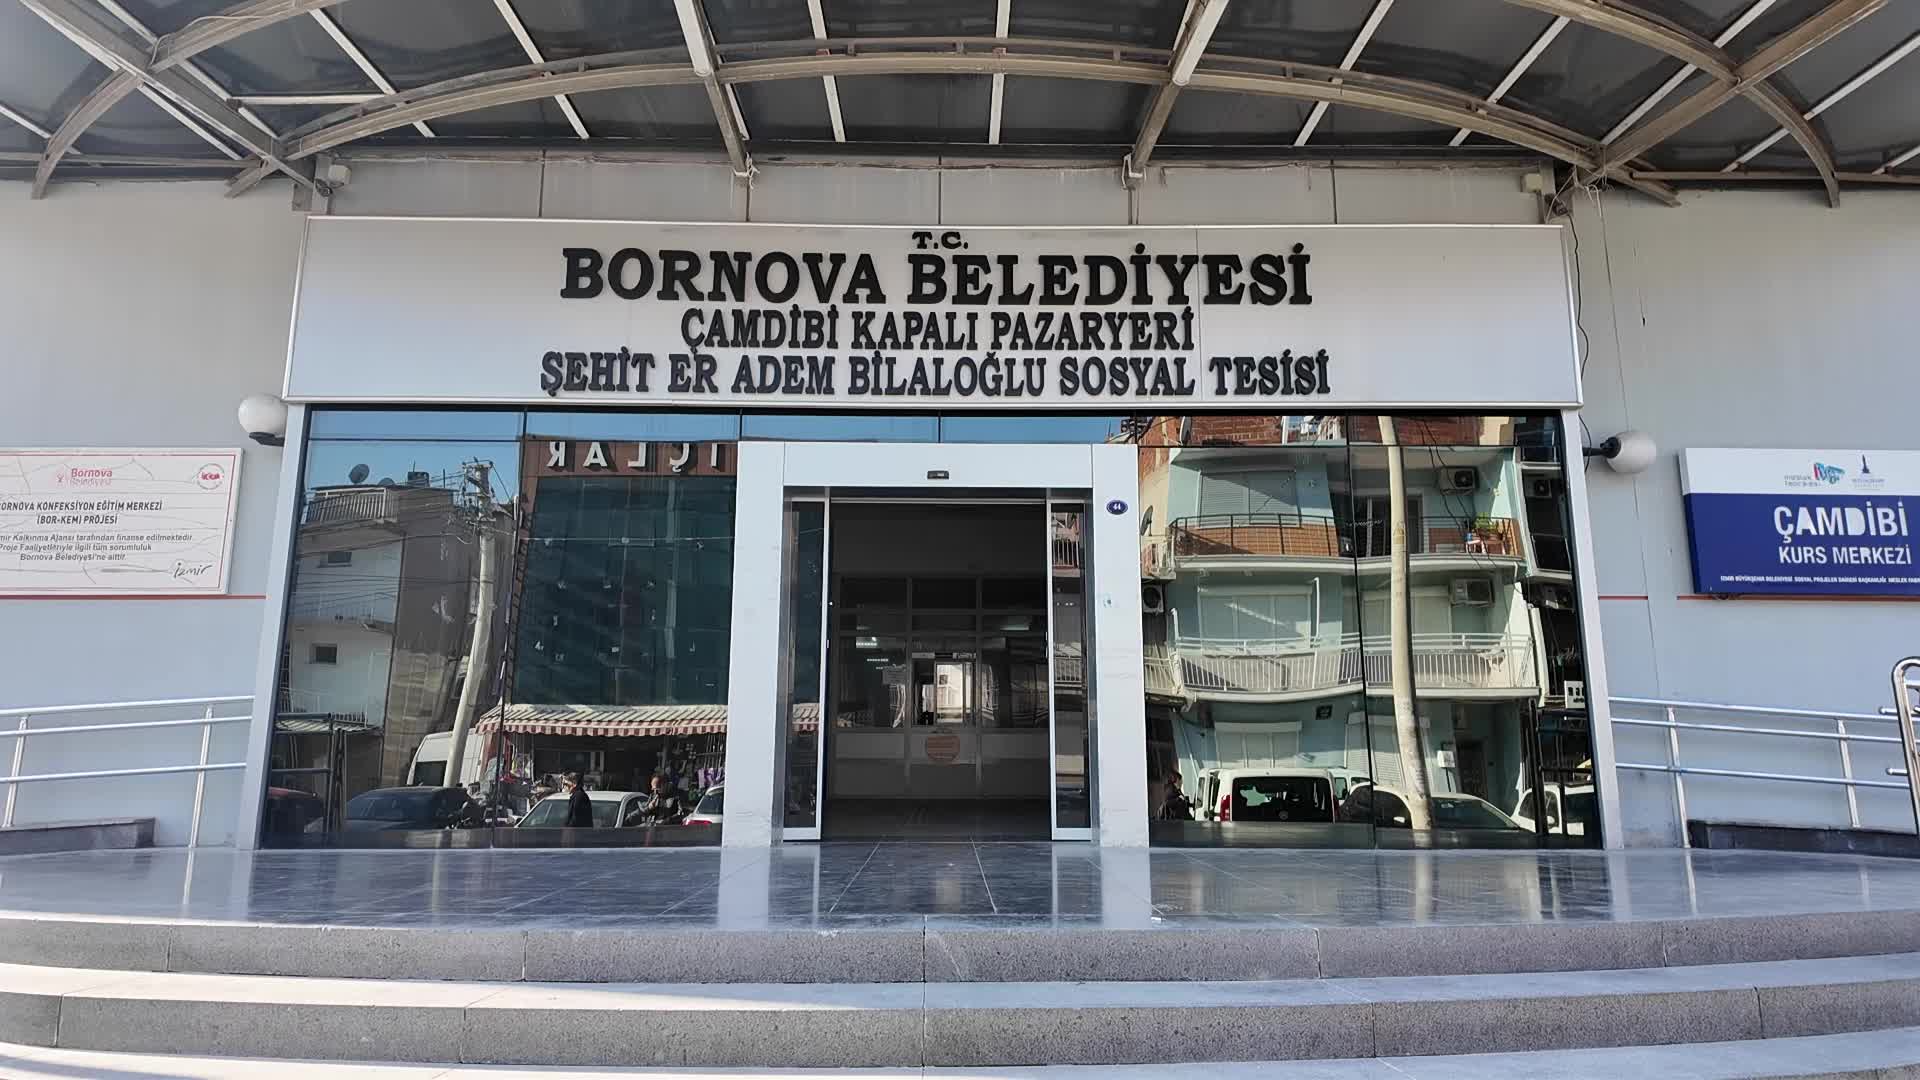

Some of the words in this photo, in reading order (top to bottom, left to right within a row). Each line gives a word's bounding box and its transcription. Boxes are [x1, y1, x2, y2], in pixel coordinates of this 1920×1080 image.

[912, 231, 969, 249] T.C.
[560, 247, 886, 304] BORNOVA
[907, 242, 1313, 305] BELEDİYESİ
[681, 304, 839, 353] ÇAMDİBİ
[851, 310, 978, 350] KAPALI
[991, 306, 1195, 351] PAZARYERİ
[540, 346, 655, 397] ŞEHİT
[667, 352, 719, 393] ER
[731, 354, 836, 395] ADEM
[848, 350, 1046, 396] BİLALOĞLU
[1060, 356, 1196, 397] SOSYAL
[1208, 348, 1331, 396] TESİSİ
[71, 468, 112, 478] Bornova
[36, 500, 95, 511] KONFEKSİYON
[96, 500, 125, 511] EĞİTİM
[126, 500, 163, 511] MERKEZİ
[36, 515, 82, 525] (BOR-KEM)
[83, 514, 118, 524] PROJESİ
[1773, 501, 1909, 543] ÇAMDİBİ
[92, 543, 108, 551] tüm
[1778, 546, 1828, 564] KURS
[1831, 544, 1912, 564] MERKEZİ
[20, 553, 53, 561] Bornova
